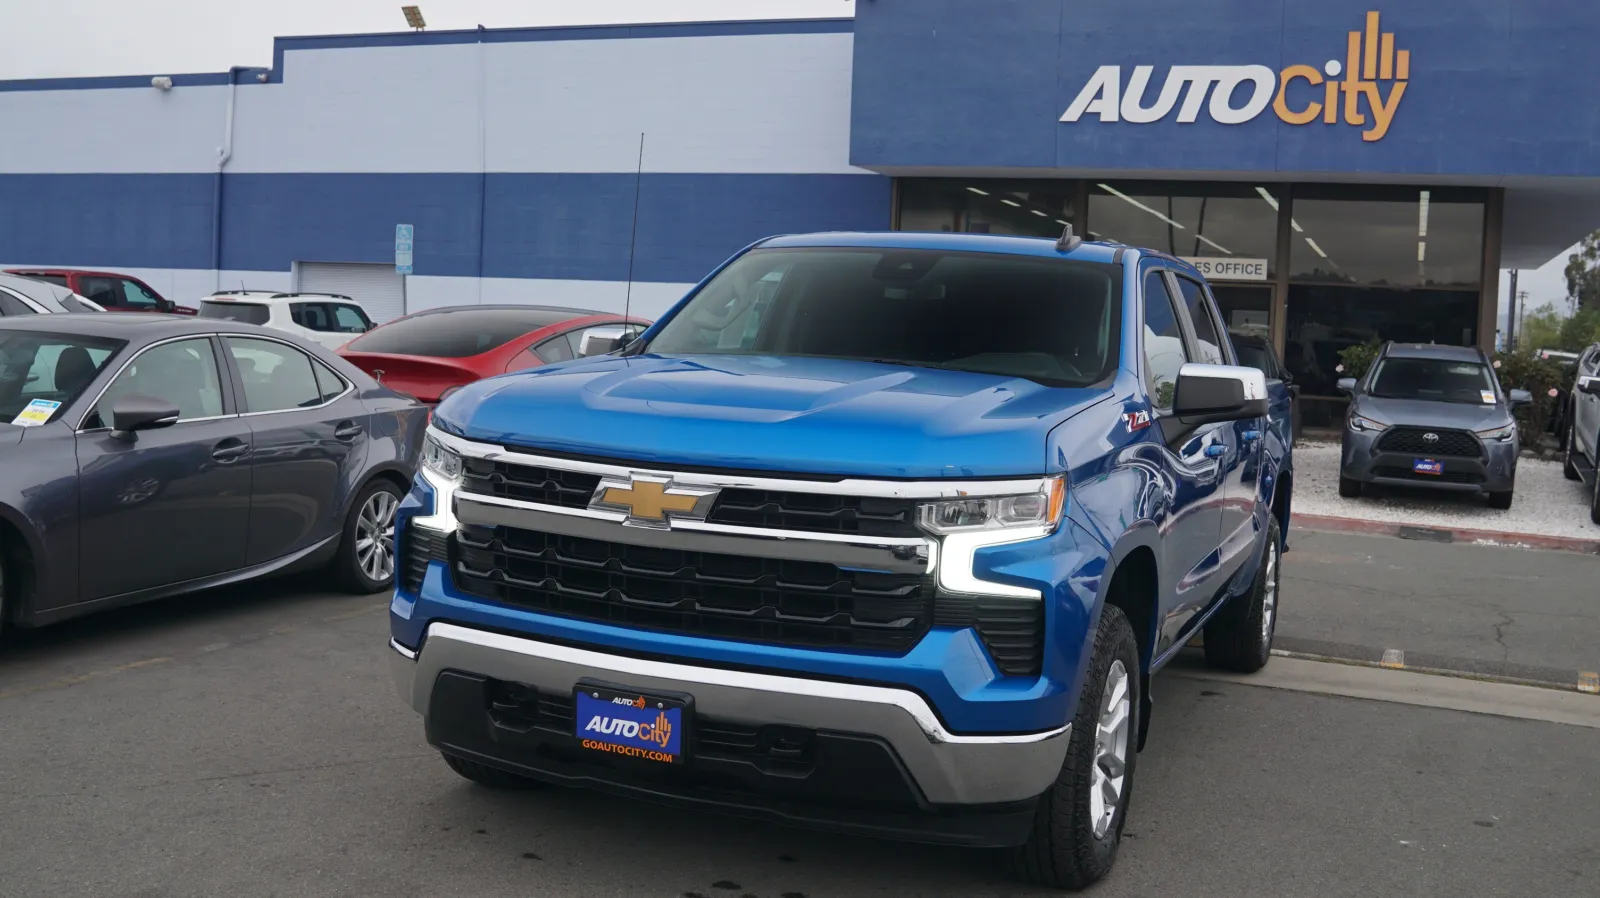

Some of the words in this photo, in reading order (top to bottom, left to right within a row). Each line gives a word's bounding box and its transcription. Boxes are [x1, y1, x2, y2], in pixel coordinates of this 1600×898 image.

[1194, 262, 1211, 274] ES
[1215, 262, 1263, 275] OFFICE
[582, 739, 673, 763] GOAUTOCITY.COM
